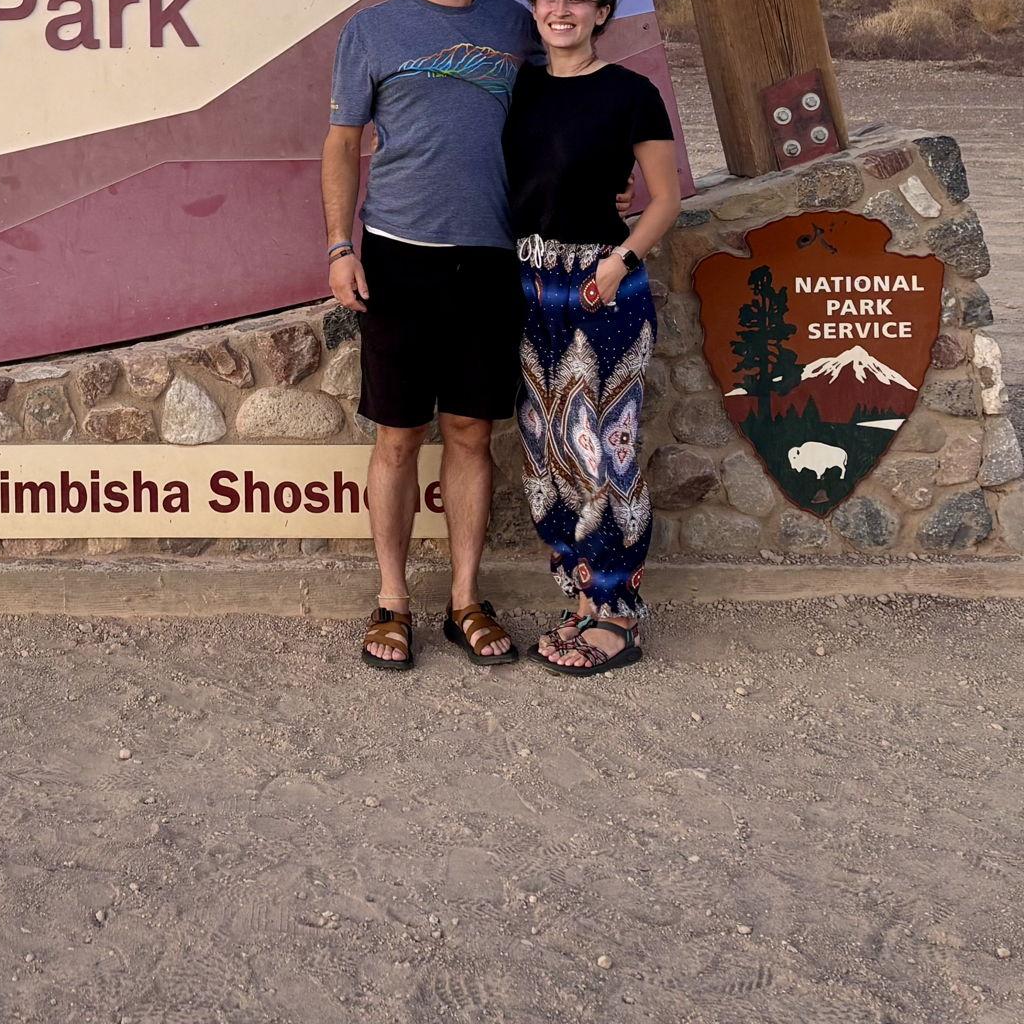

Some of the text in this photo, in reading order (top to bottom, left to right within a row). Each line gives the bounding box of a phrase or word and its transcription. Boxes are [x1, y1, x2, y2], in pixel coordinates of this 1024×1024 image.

[795, 275, 925, 294] NATIONAL
[826, 298, 893, 316] PARK
[808, 321, 913, 340] SERVICE
[208, 469, 445, 514] Shoshe
